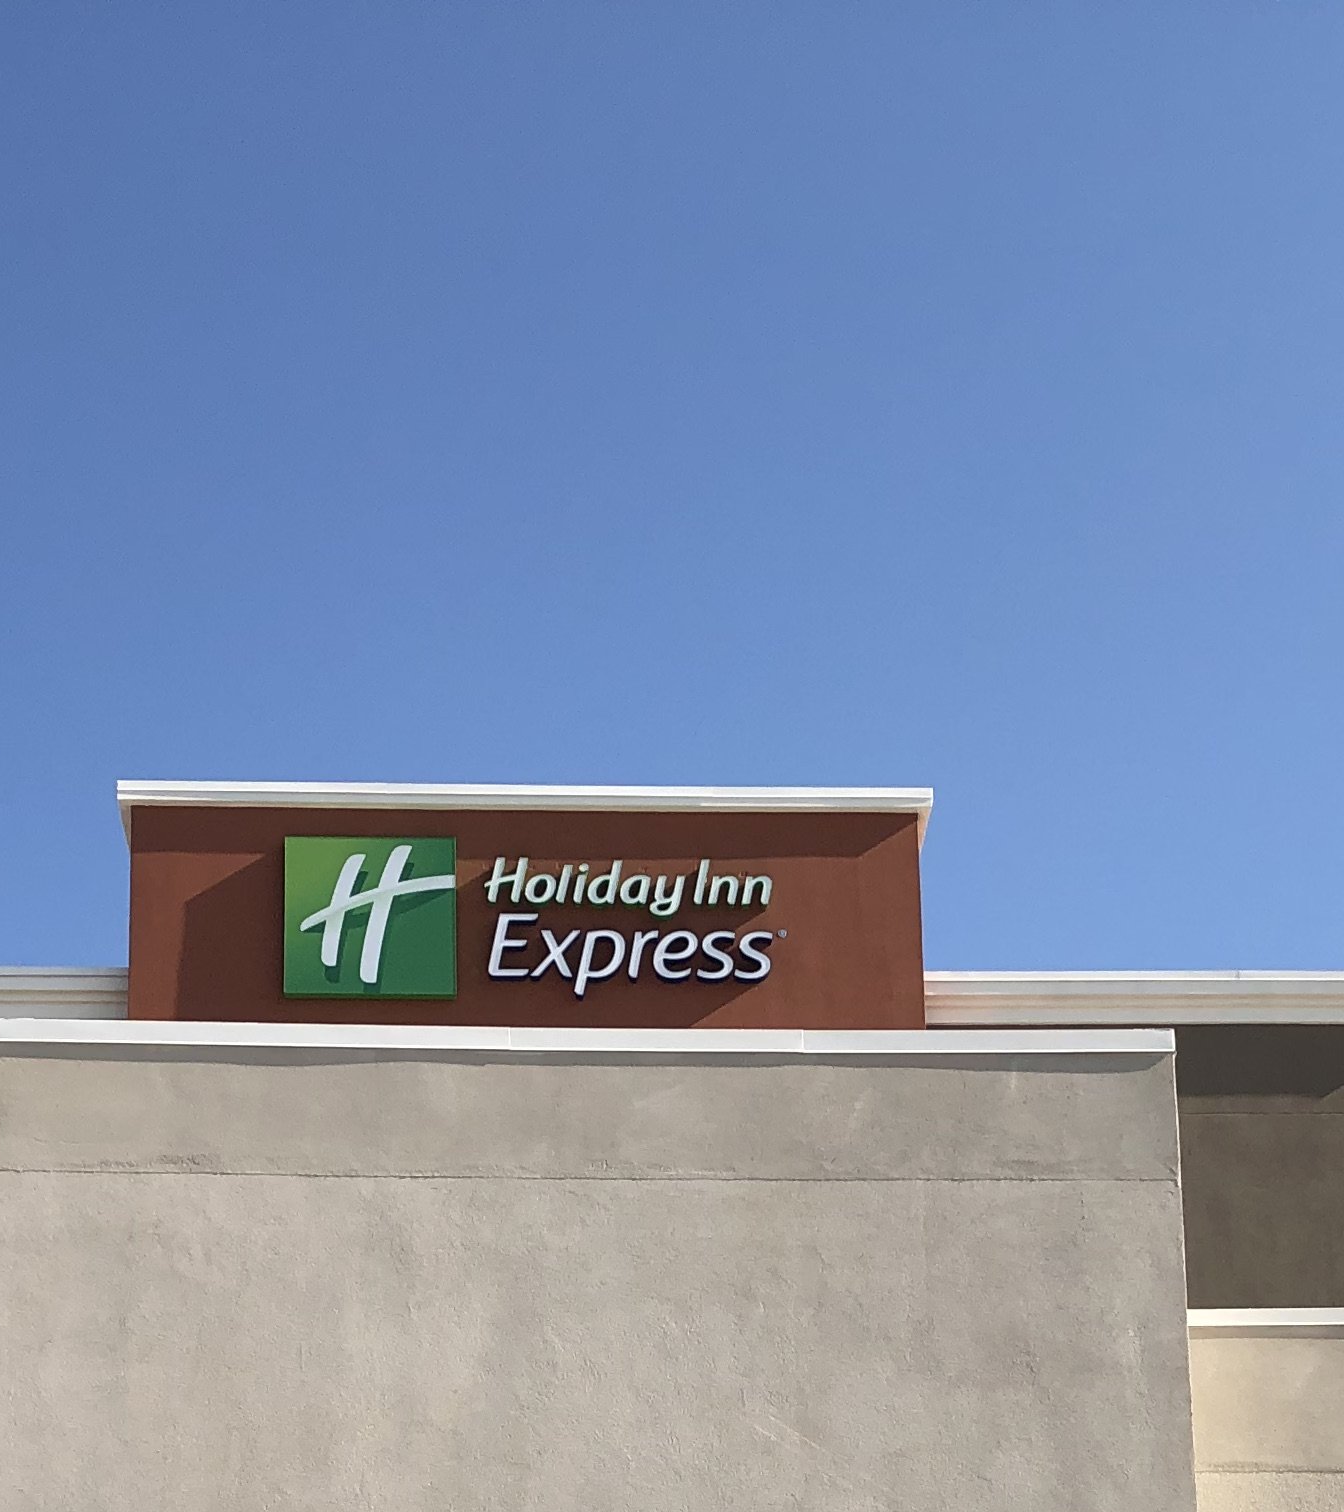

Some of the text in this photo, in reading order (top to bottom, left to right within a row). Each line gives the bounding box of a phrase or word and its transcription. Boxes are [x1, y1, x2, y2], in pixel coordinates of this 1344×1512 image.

[483, 856, 773, 916] Holiday Inn
[487, 912, 774, 996] Express
